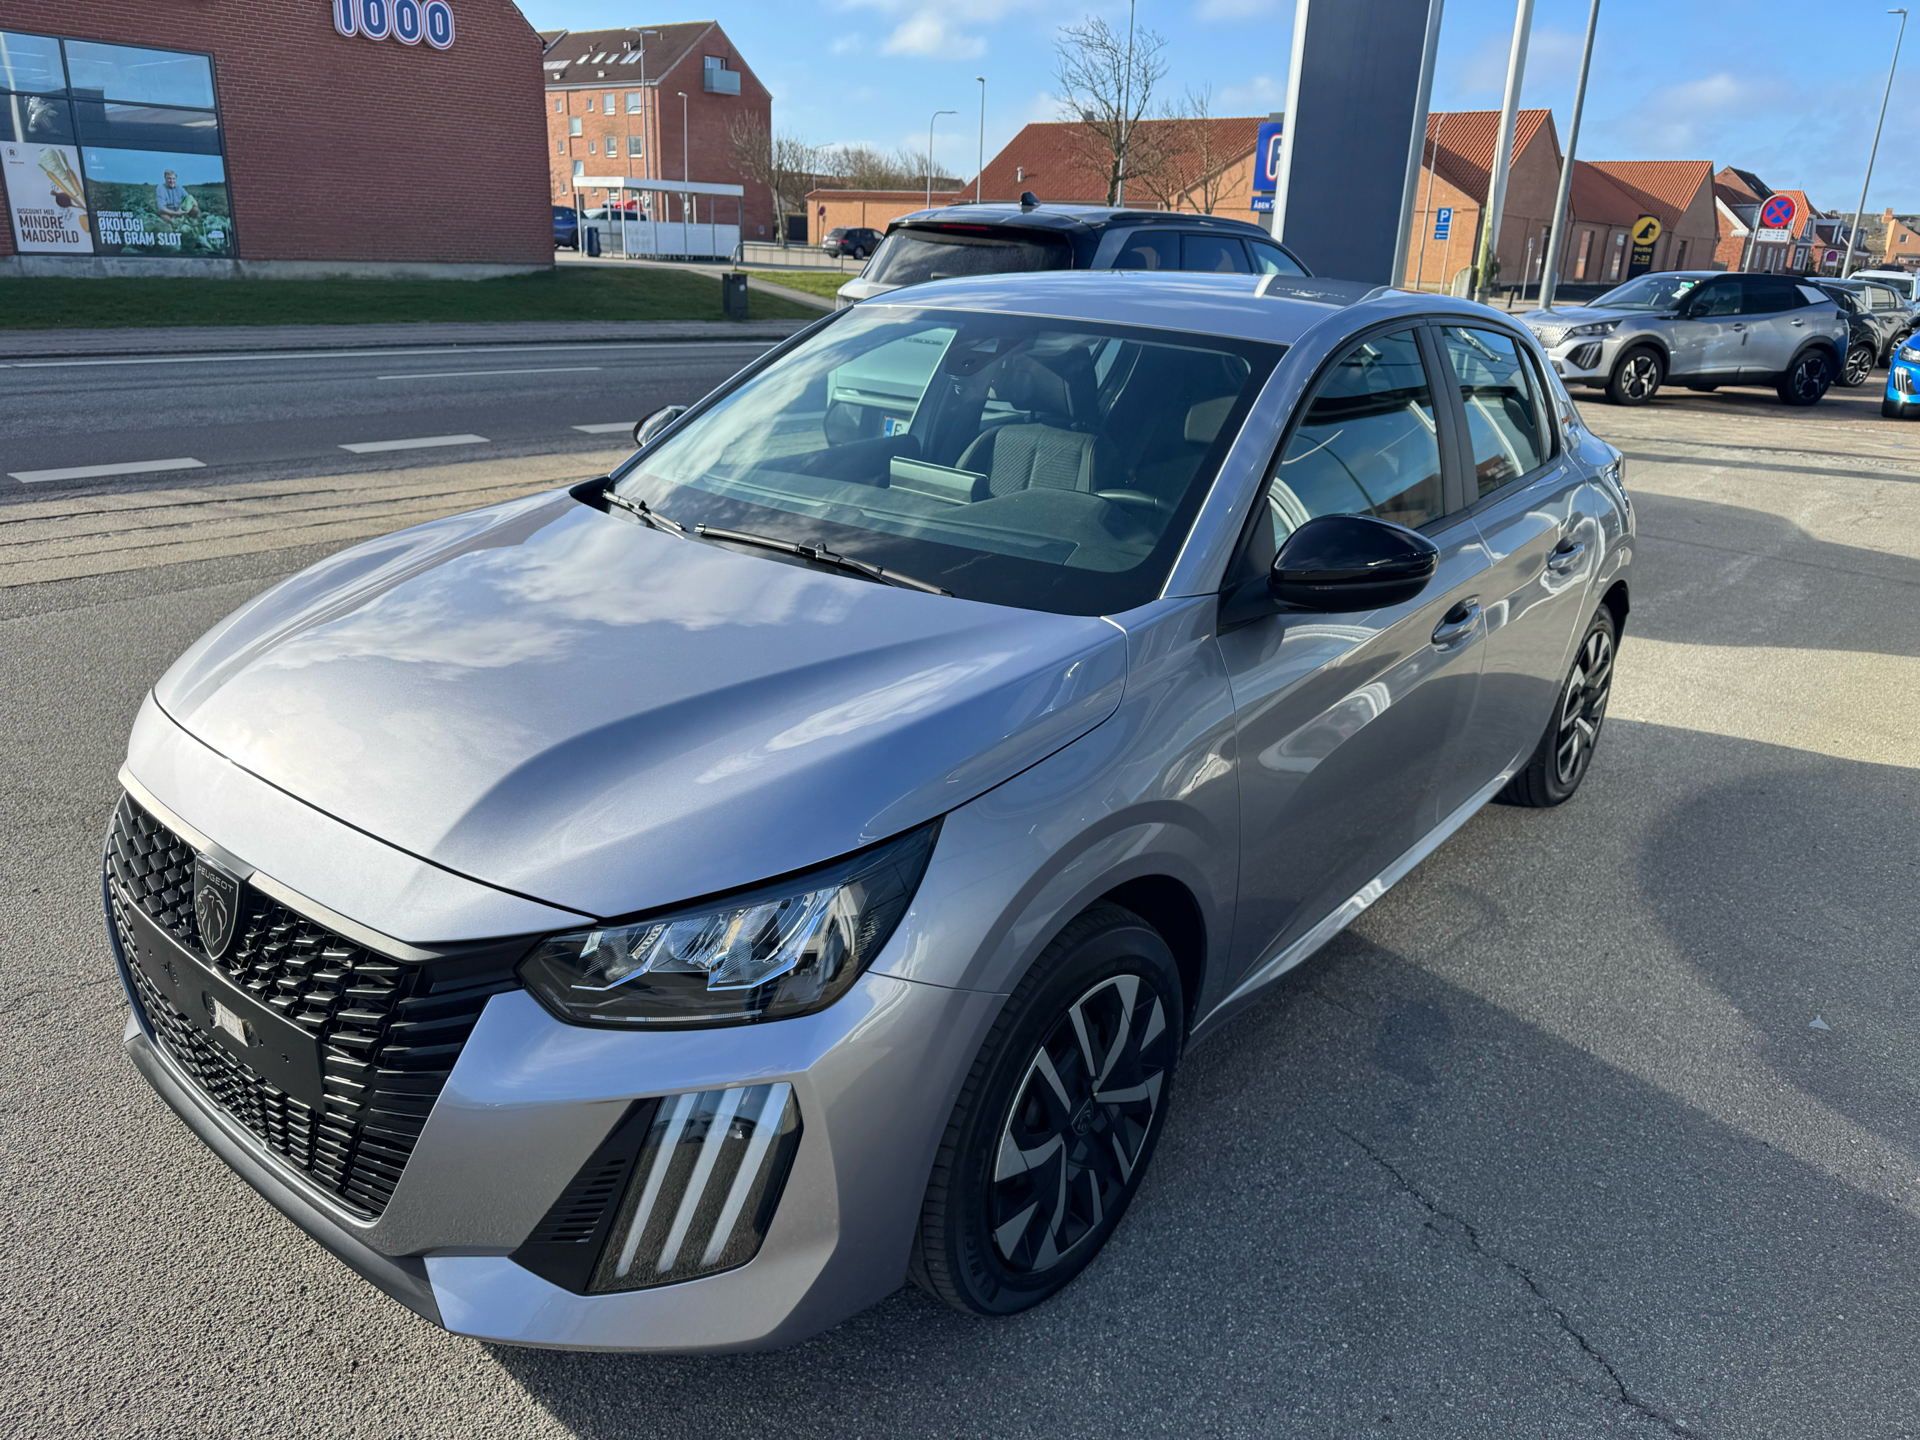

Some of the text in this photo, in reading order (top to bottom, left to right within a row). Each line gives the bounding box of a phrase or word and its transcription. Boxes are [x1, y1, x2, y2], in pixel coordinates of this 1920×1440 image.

[334, 0, 455, 50] 1000
[97, 210, 121, 218] DISCOUNT
[1440, 210, 1449, 222] P
[19, 215, 65, 229] MINDRE
[98, 217, 144, 232] ØKOLOGI
[21, 229, 79, 243] MADSPILD
[100, 231, 182, 246] FRA GRAM SLOT
[197, 864, 234, 893] PEUGEOT
